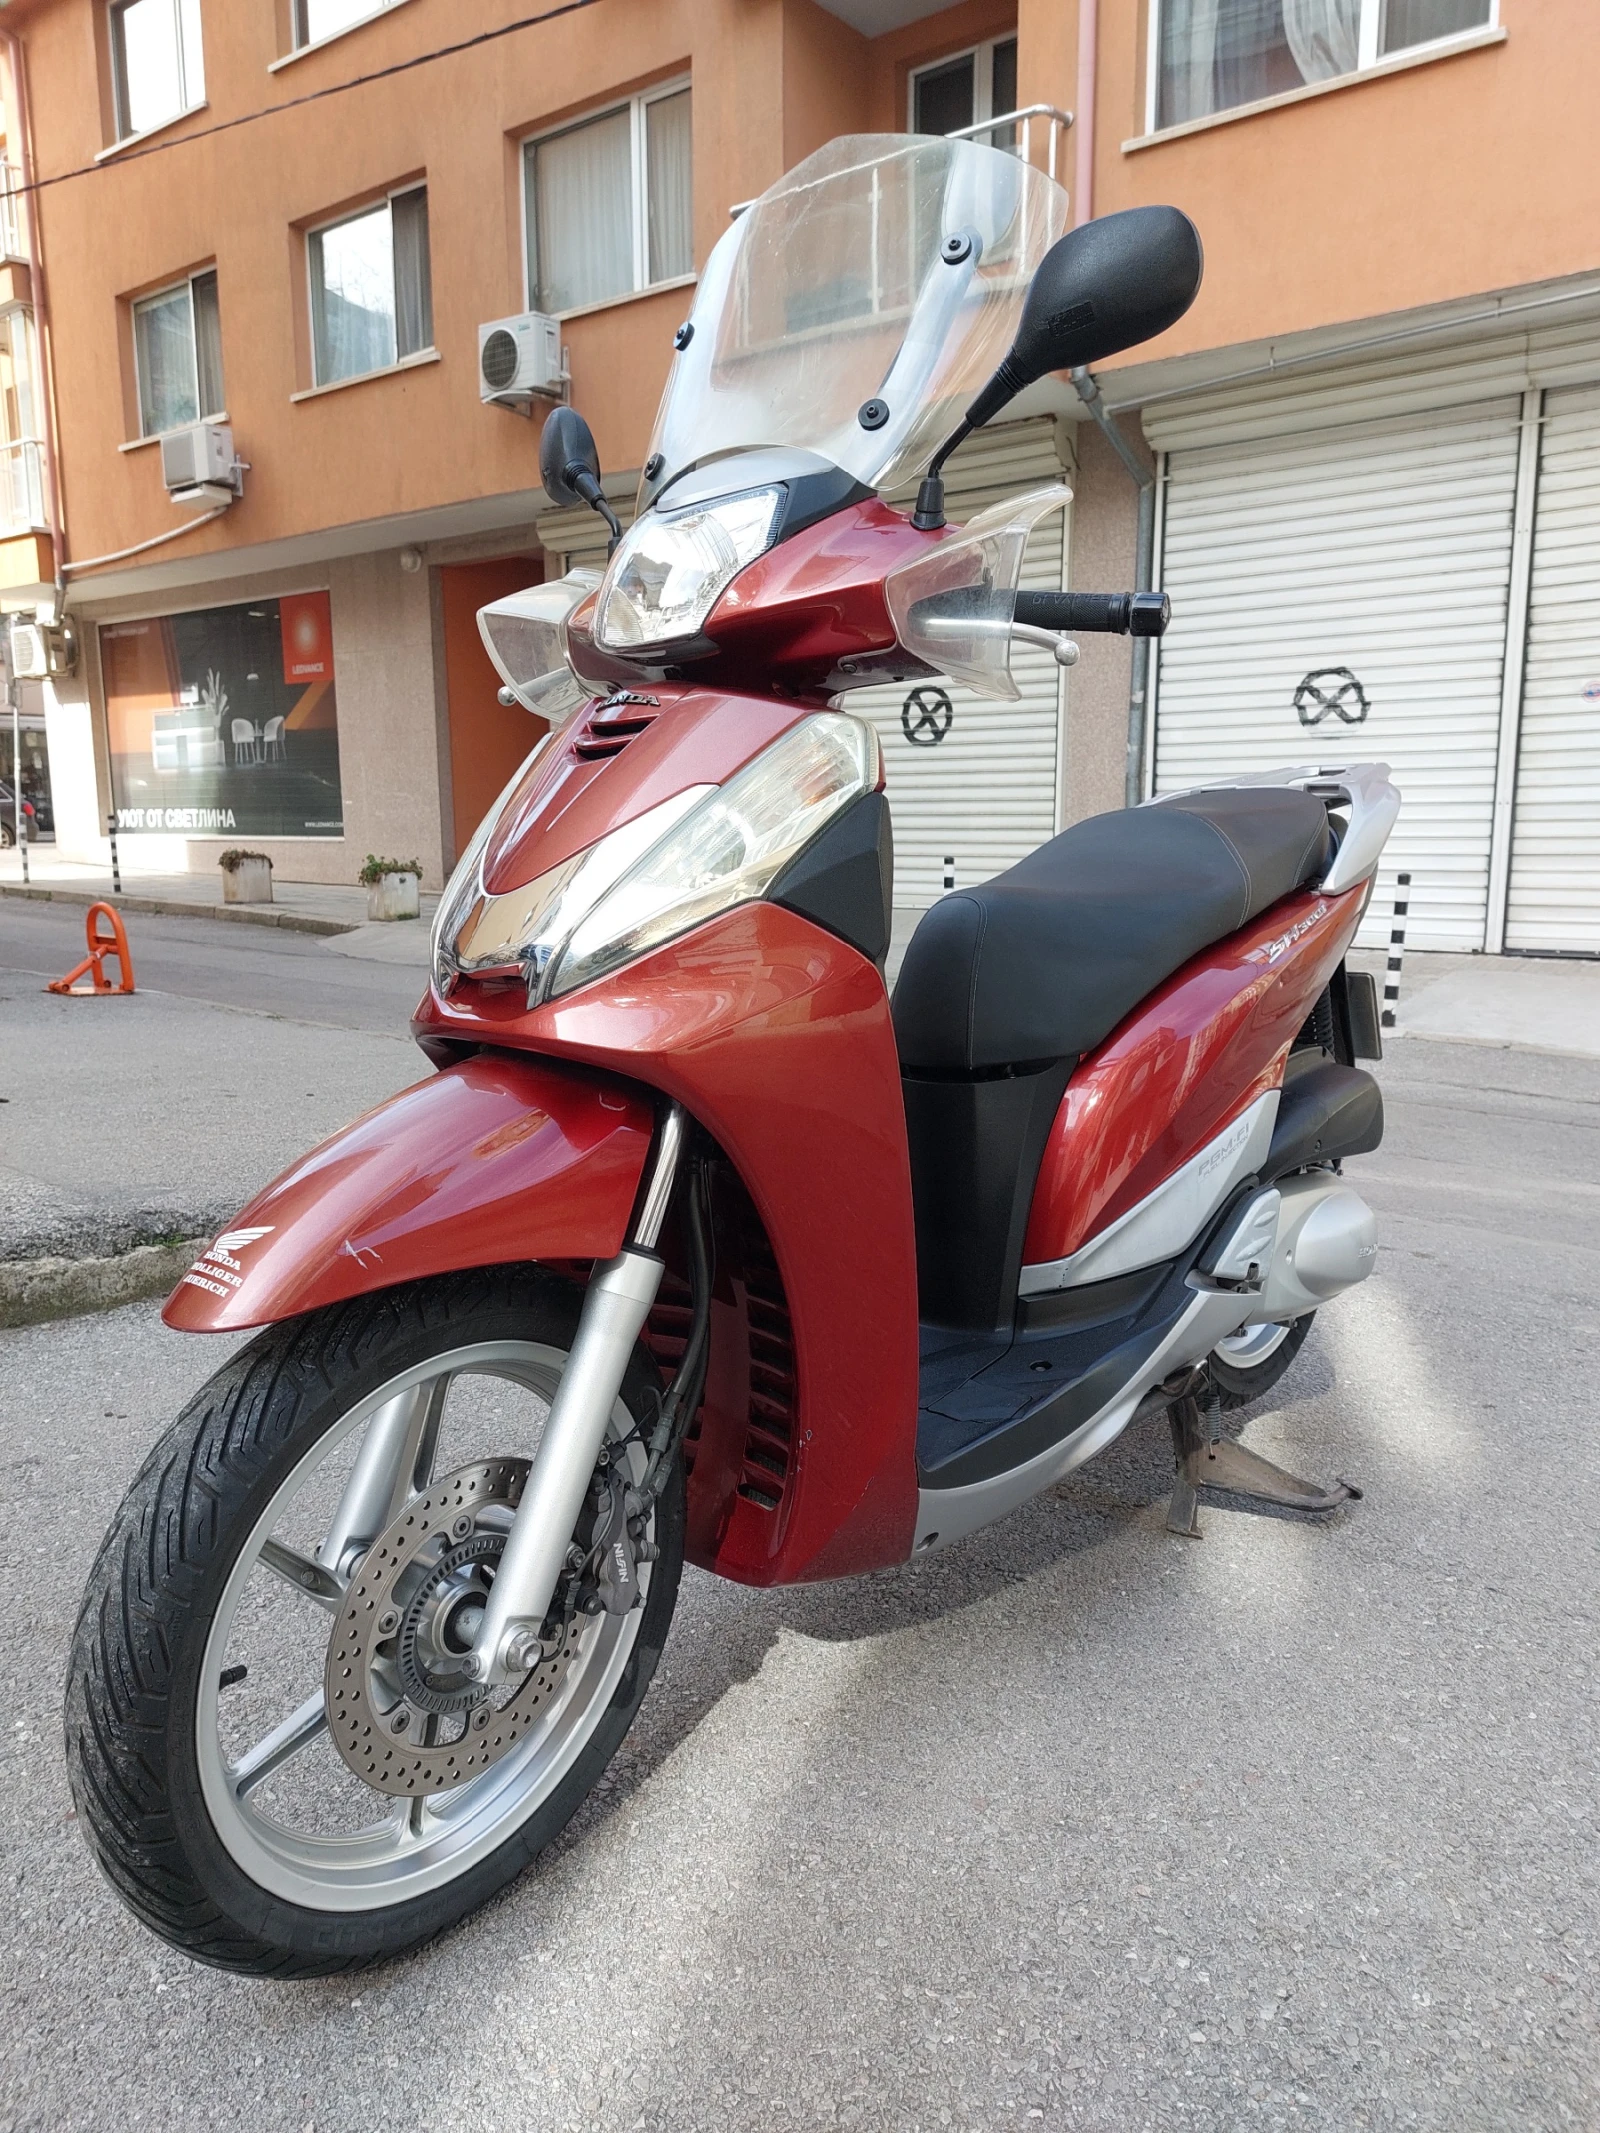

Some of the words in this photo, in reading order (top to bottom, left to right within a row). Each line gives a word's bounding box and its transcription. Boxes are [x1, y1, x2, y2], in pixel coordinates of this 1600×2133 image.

[146, 808, 164, 828] ОТ
[165, 808, 236, 828] СВЕТЛИНА
[204, 1251, 241, 1270] HONDA
